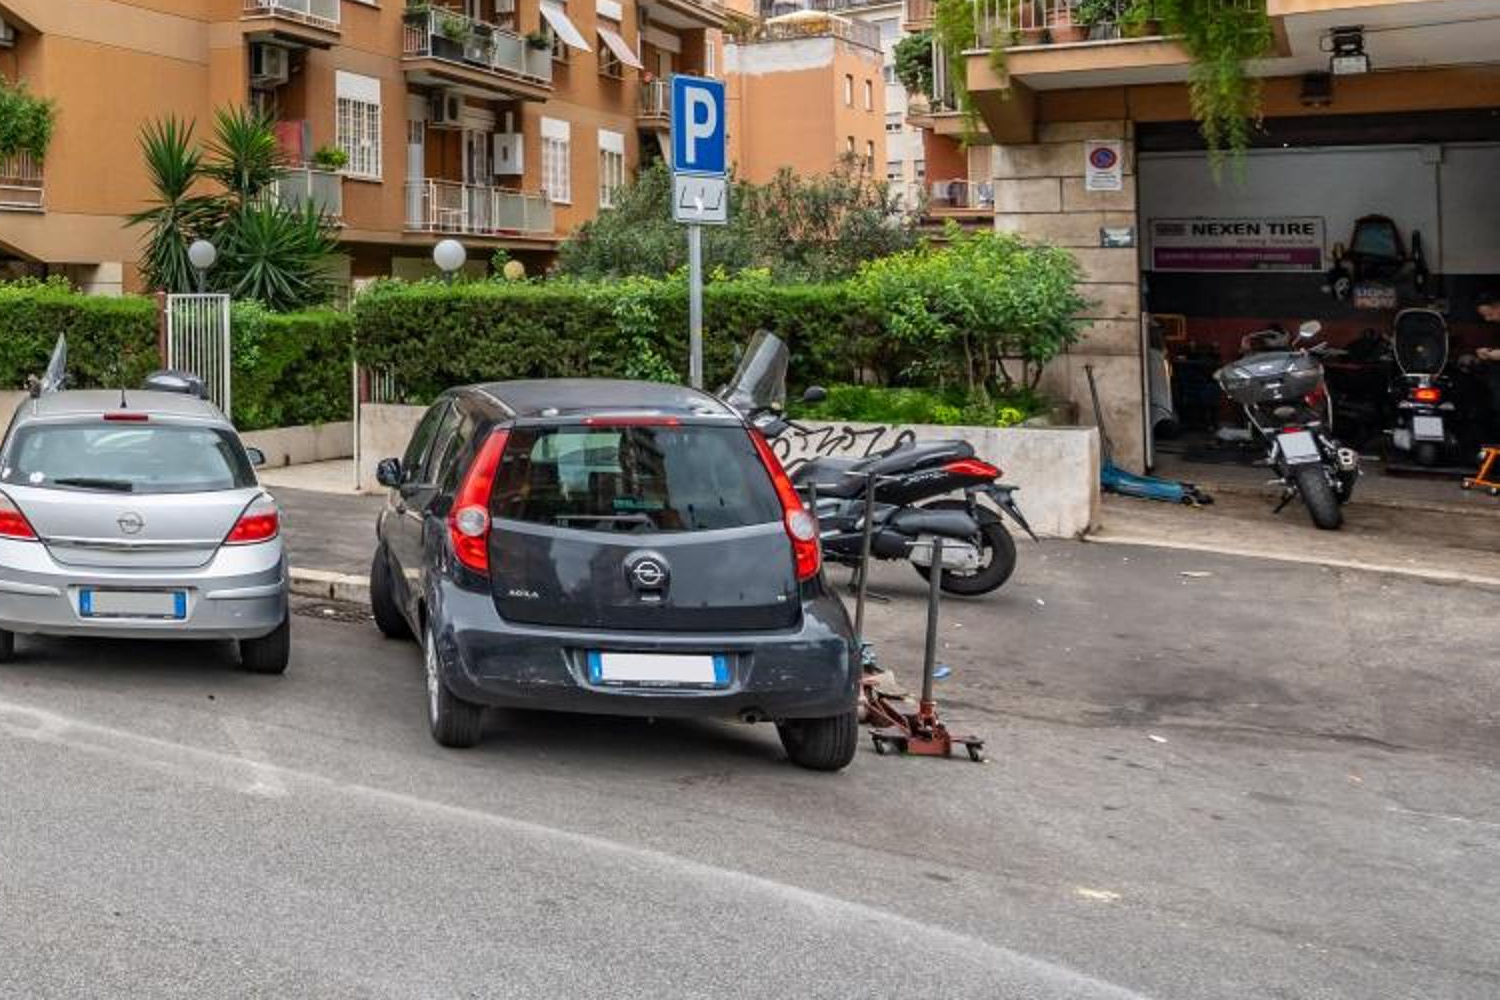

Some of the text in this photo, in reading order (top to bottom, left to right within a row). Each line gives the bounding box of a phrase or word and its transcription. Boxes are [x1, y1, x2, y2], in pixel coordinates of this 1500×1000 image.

[685, 86, 717, 164] P
[1191, 223, 1260, 236] NEXEN
[1266, 222, 1315, 236] TIRE
